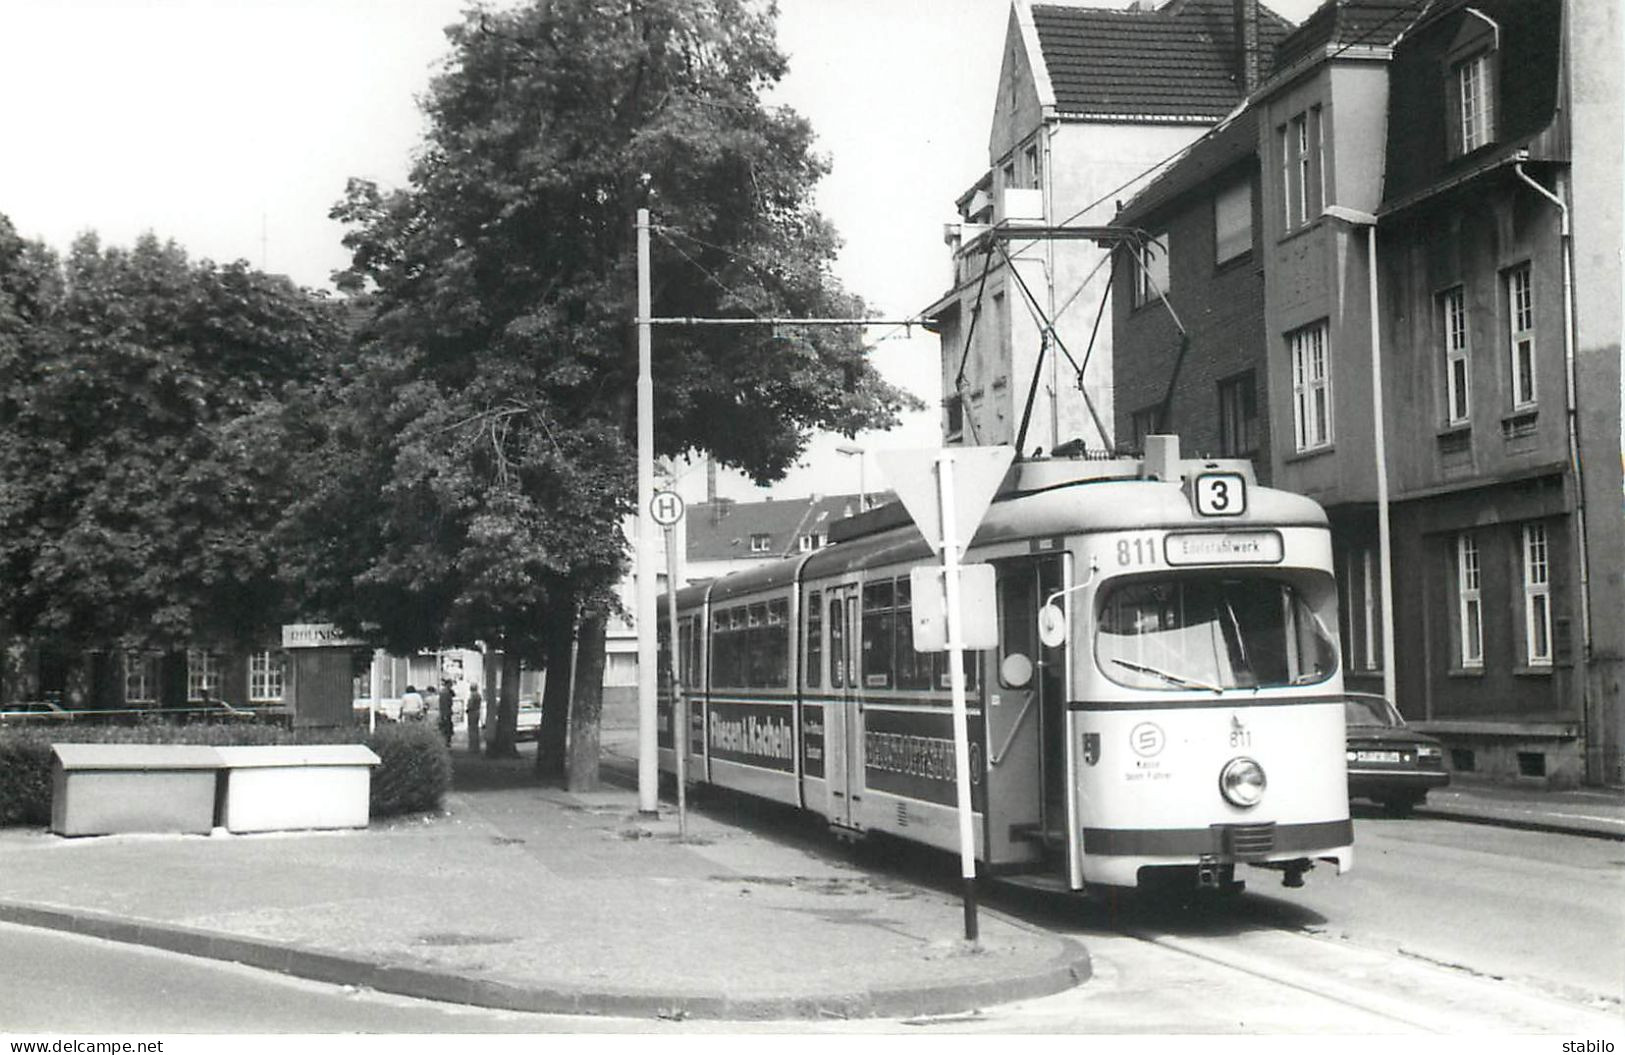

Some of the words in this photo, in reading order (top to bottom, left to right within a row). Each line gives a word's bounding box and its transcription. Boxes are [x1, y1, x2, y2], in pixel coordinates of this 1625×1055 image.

[1210, 480, 1229, 511] 3
[659, 498, 676, 518] H
[1117, 537, 1156, 566] 811
[1229, 731, 1251, 748] 811
